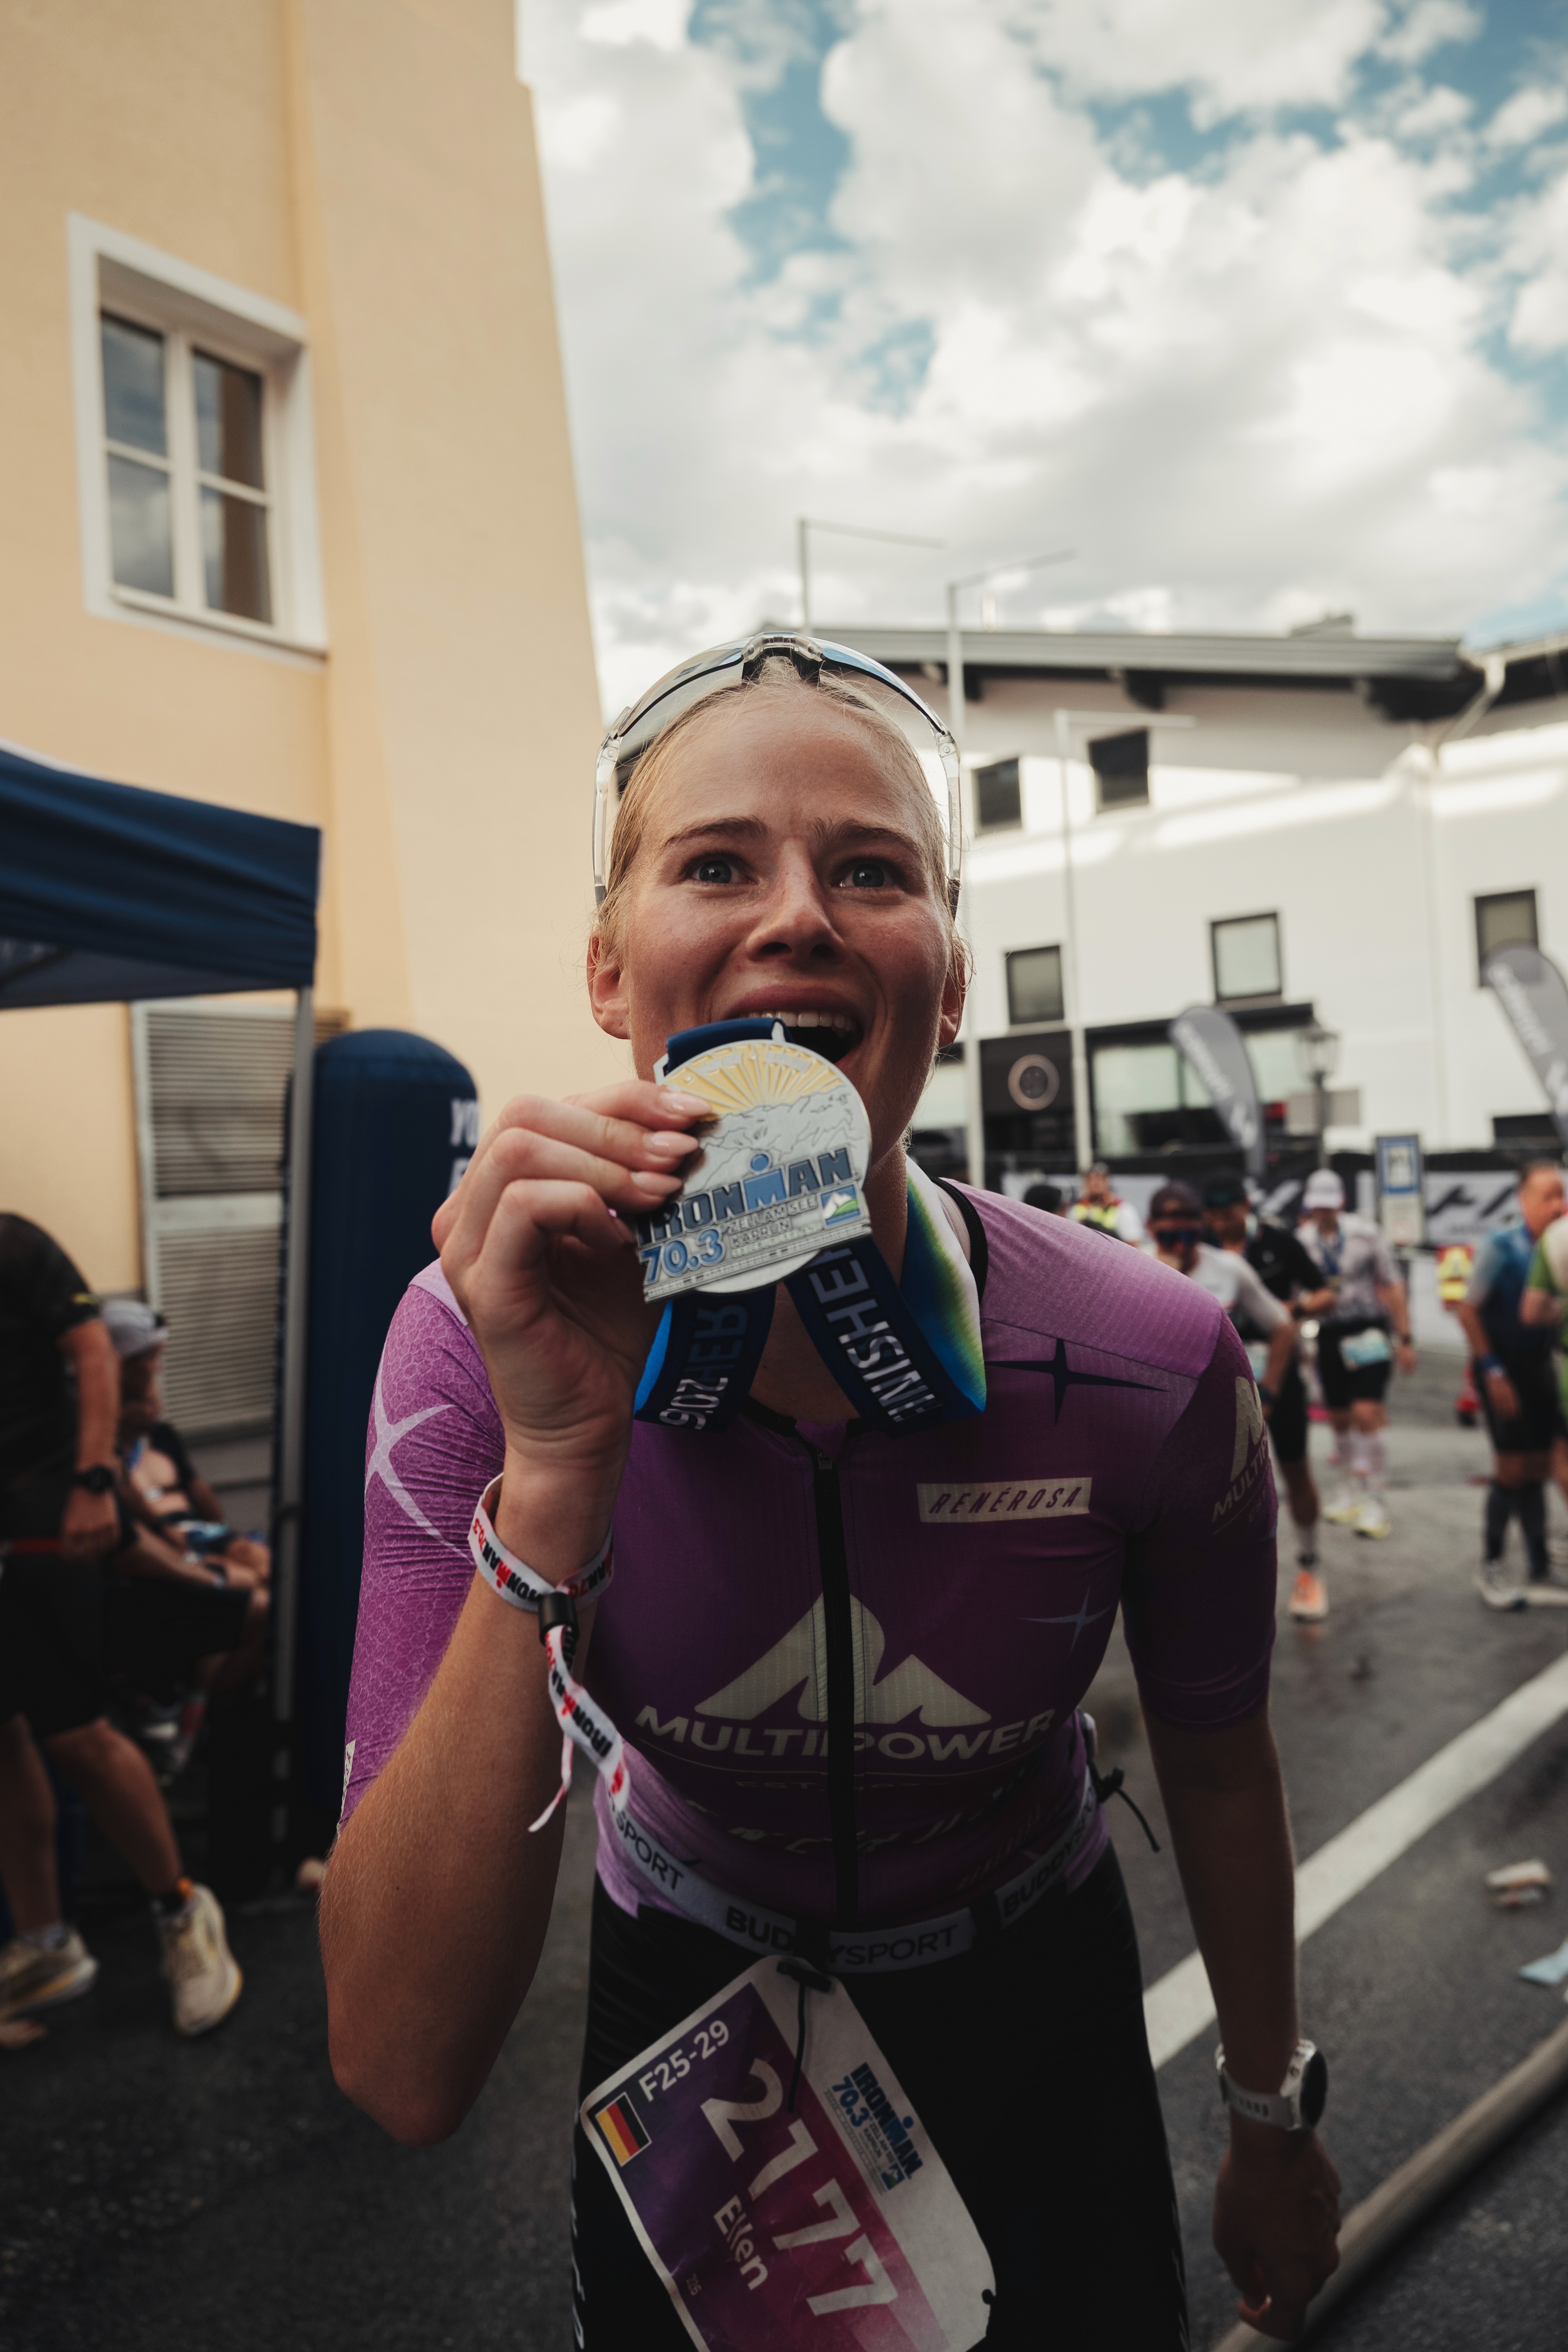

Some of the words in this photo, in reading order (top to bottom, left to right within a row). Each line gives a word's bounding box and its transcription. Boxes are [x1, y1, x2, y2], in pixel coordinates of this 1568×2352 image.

[638, 1147, 852, 1246] IRONMAN
[788, 1195, 818, 1215] SEE
[641, 1229, 724, 1283] 70.3
[803, 1248, 936, 1422] INISHE
[658, 1377, 729, 1430] 206
[929, 1486, 1082, 1514] RENÉROSA
[482, 1540, 545, 1602] RONMAN
[613, 1805, 684, 1890] SPORT
[639, 2020, 730, 2102] F25-29
[832, 2075, 870, 2127] 70.3
[850, 2062, 924, 2176] IRONMAN
[700, 2058, 899, 2316] 2177
[713, 2195, 769, 2290] Ellen
